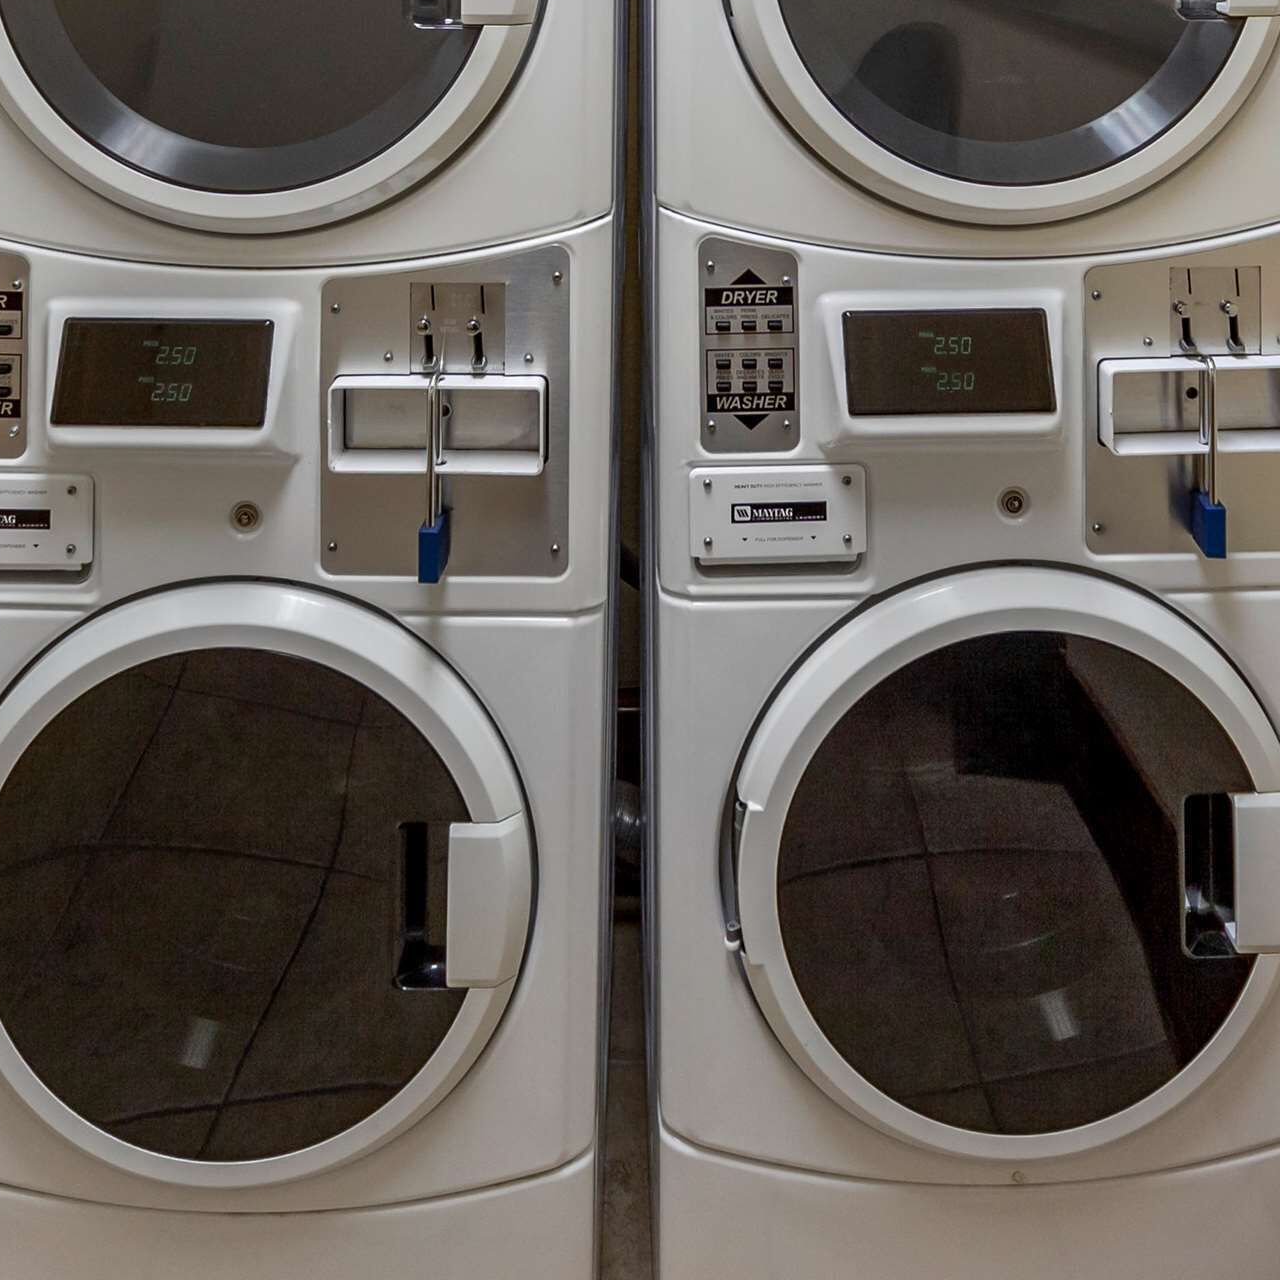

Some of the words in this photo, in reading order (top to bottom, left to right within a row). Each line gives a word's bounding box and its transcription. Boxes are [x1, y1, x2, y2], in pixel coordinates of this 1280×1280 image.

[720, 290, 778, 304] DRYER
[716, 395, 787, 409] WASHER
[752, 508, 793, 517] MAYTAG
